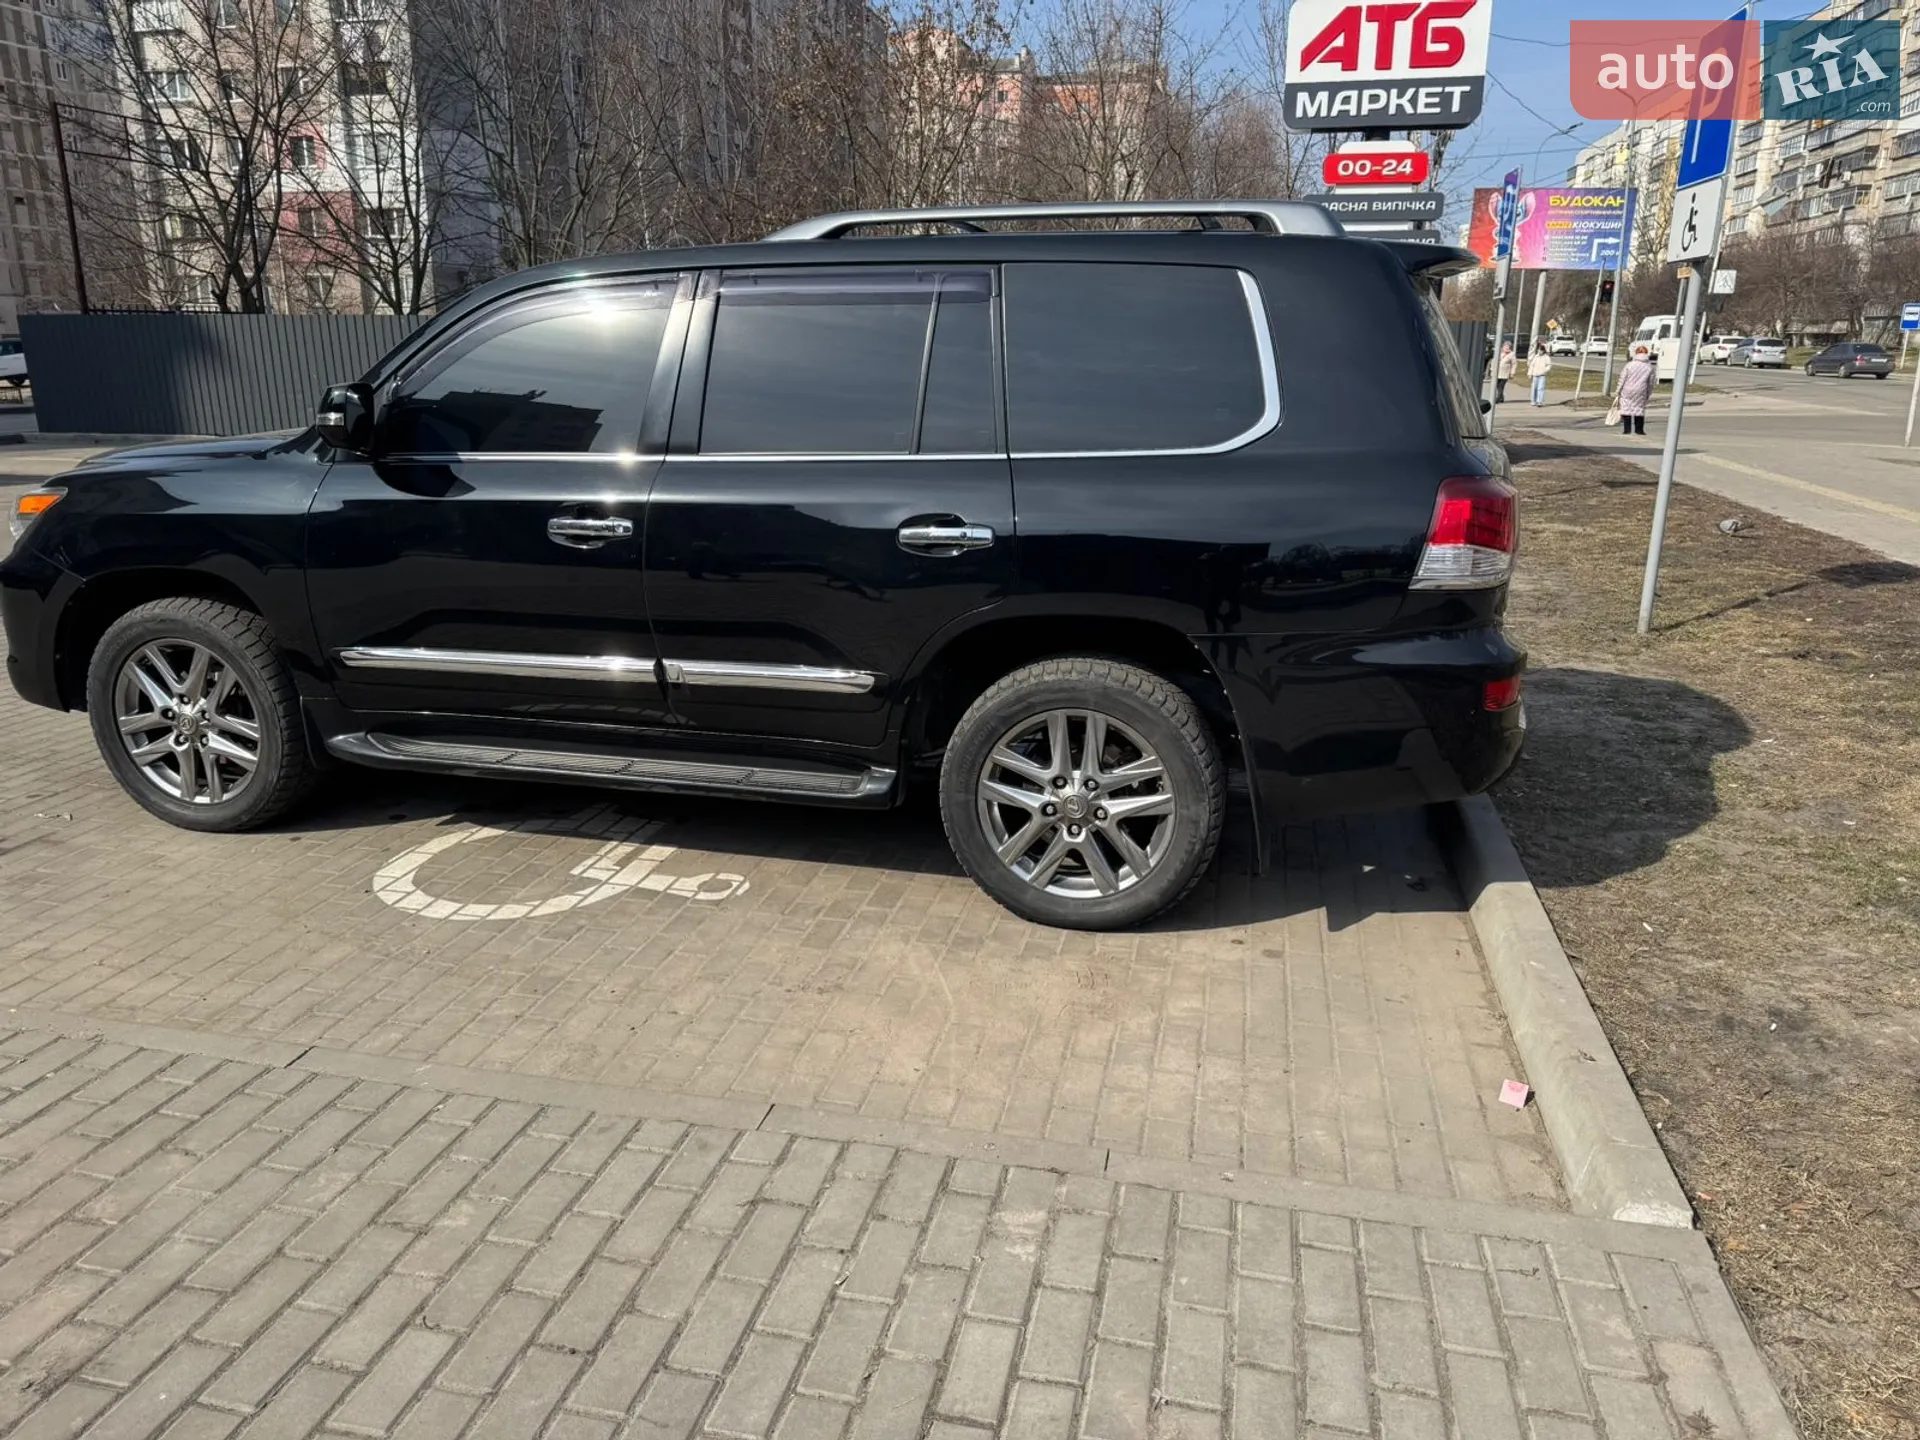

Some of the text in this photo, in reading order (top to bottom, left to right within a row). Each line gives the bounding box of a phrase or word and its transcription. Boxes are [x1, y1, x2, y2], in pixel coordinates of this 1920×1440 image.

[1300, 0, 1477, 72] АТБ
[1295, 86, 1471, 118] МАРКЕТ
[1337, 158, 1414, 176] 00-24
[1321, 200, 1437, 212] АСНА ВИПІЧКА
[1549, 195, 1625, 207] БУДОКАН
